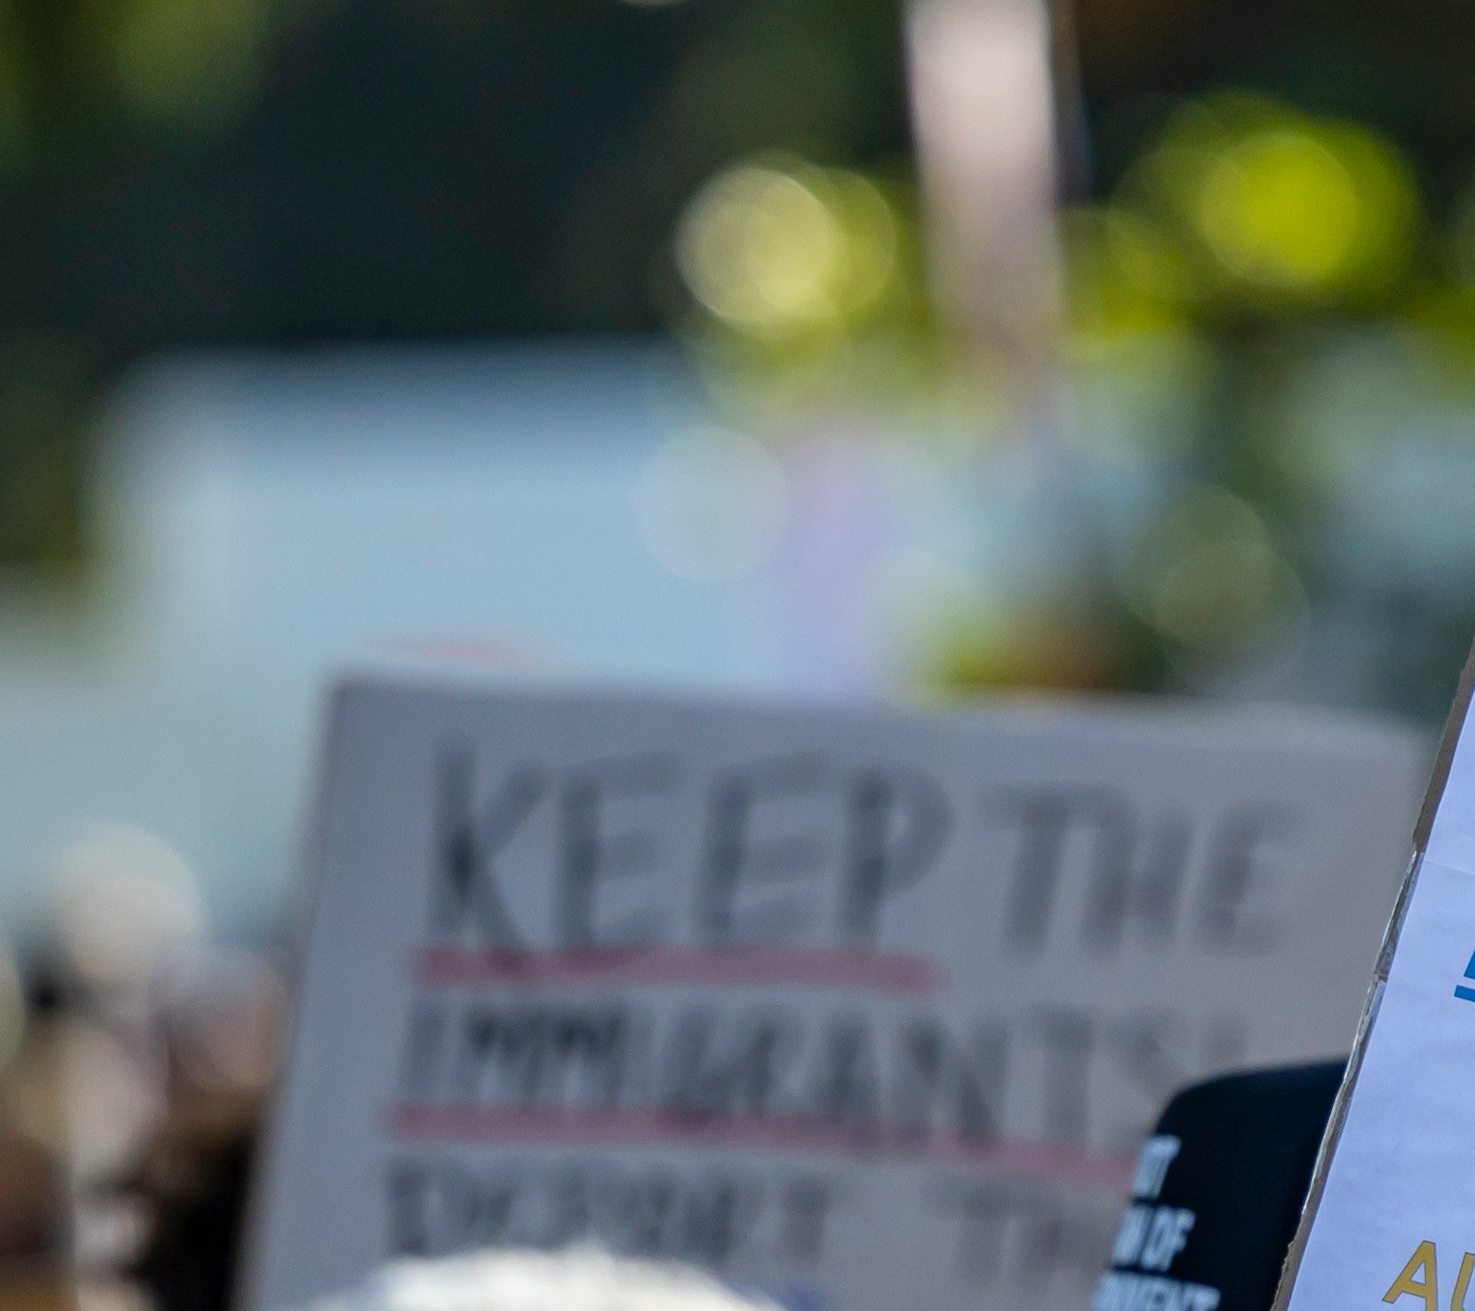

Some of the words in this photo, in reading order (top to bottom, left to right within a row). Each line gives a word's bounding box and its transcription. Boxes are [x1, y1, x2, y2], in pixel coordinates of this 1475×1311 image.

[425, 727, 955, 957] KEEP
[978, 778, 1302, 961] THE
[1141, 1206, 1196, 1271] OF
